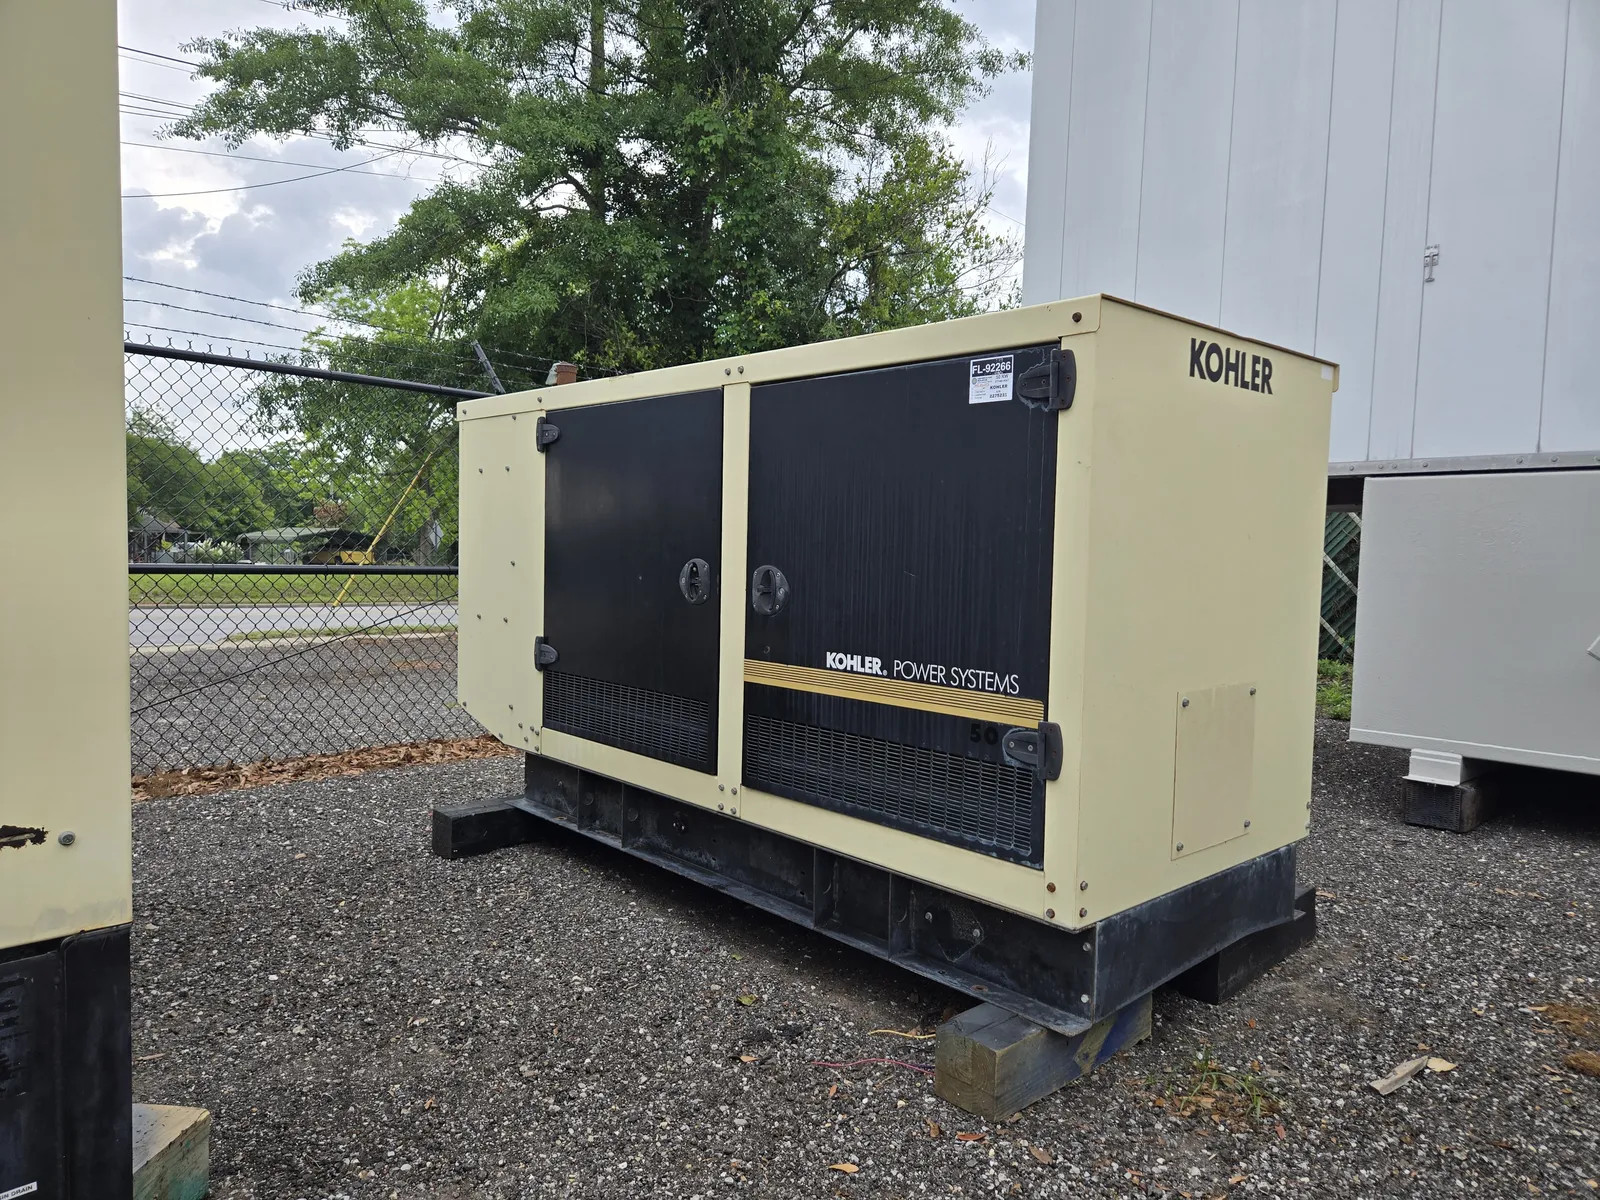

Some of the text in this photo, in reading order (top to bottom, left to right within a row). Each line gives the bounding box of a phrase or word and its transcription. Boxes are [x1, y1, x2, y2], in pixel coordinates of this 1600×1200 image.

[972, 361, 1011, 374] FL-92266
[1189, 337, 1273, 395] KOHLER
[893, 659, 947, 684] POWER
[950, 667, 1020, 695] SYSTEMS
[970, 723, 998, 745] 50
[11, 1185, 33, 1197] DRAIN
